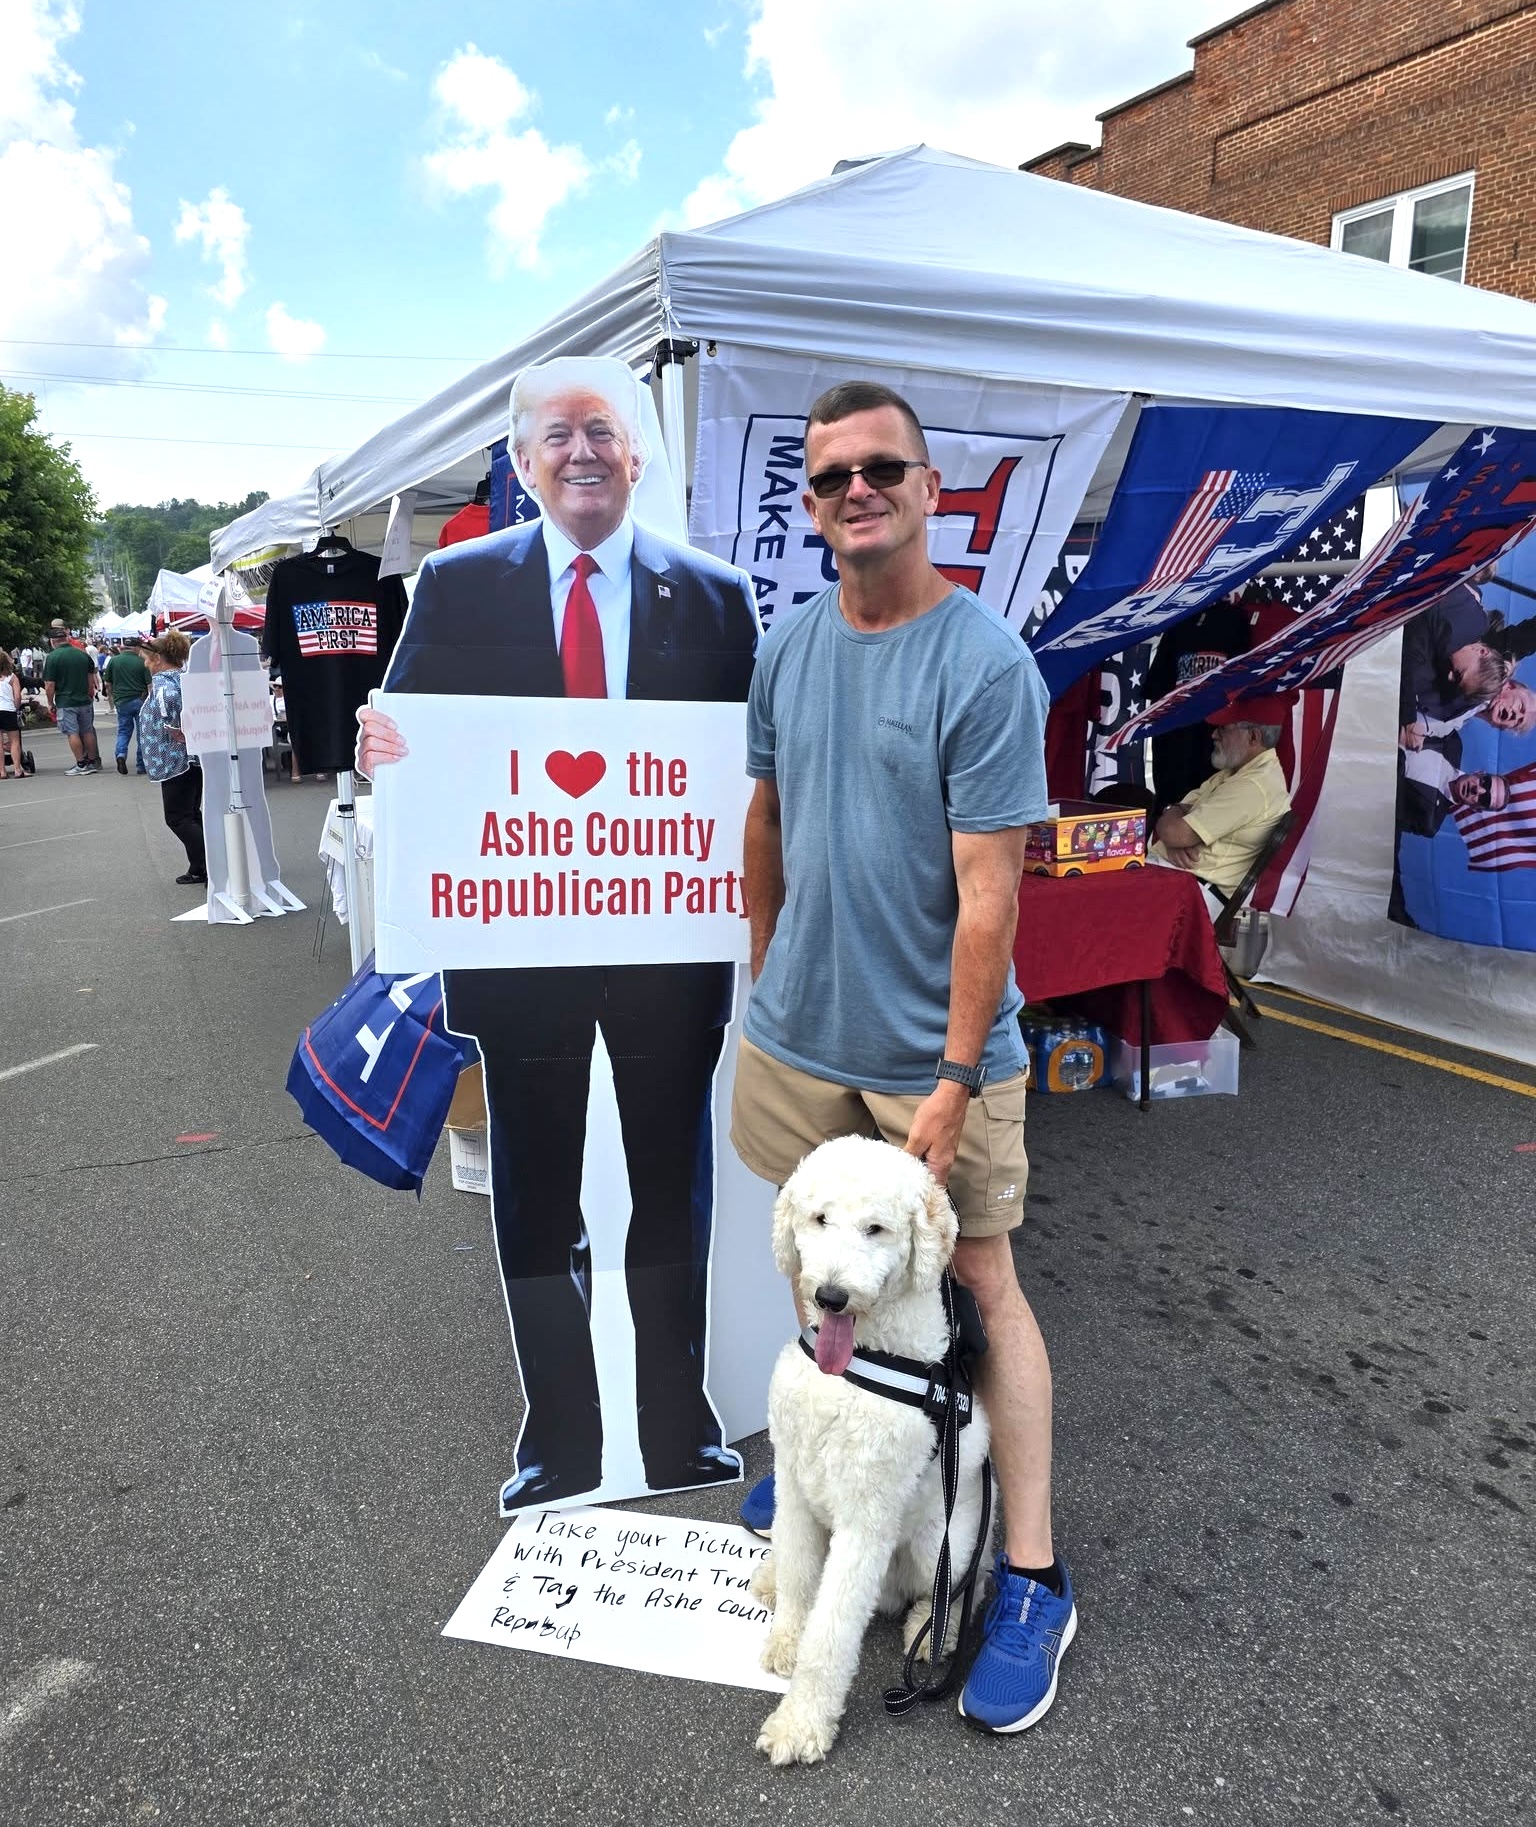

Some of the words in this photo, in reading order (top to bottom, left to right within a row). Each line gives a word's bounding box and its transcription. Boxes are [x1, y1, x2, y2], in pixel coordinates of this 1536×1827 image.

[753, 435, 805, 562] MAKE
[299, 606, 373, 628] AMERICA
[316, 630, 359, 650] FIRST
[510, 750, 519, 796] I
[626, 751, 687, 797] the
[479, 811, 573, 857] Ashe
[586, 811, 716, 862] County
[431, 869, 651, 925] Republican
[664, 870, 750, 920] Party
[535, 1510, 597, 1540] Take
[614, 1527, 667, 1557] your
[684, 1530, 773, 1561] Picture
[532, 1575, 579, 1609] Tag
[593, 1583, 626, 1606] the
[644, 1587, 703, 1611] Ashe
[580, 1549, 699, 1582] President
[710, 1568, 752, 1591] Tru
